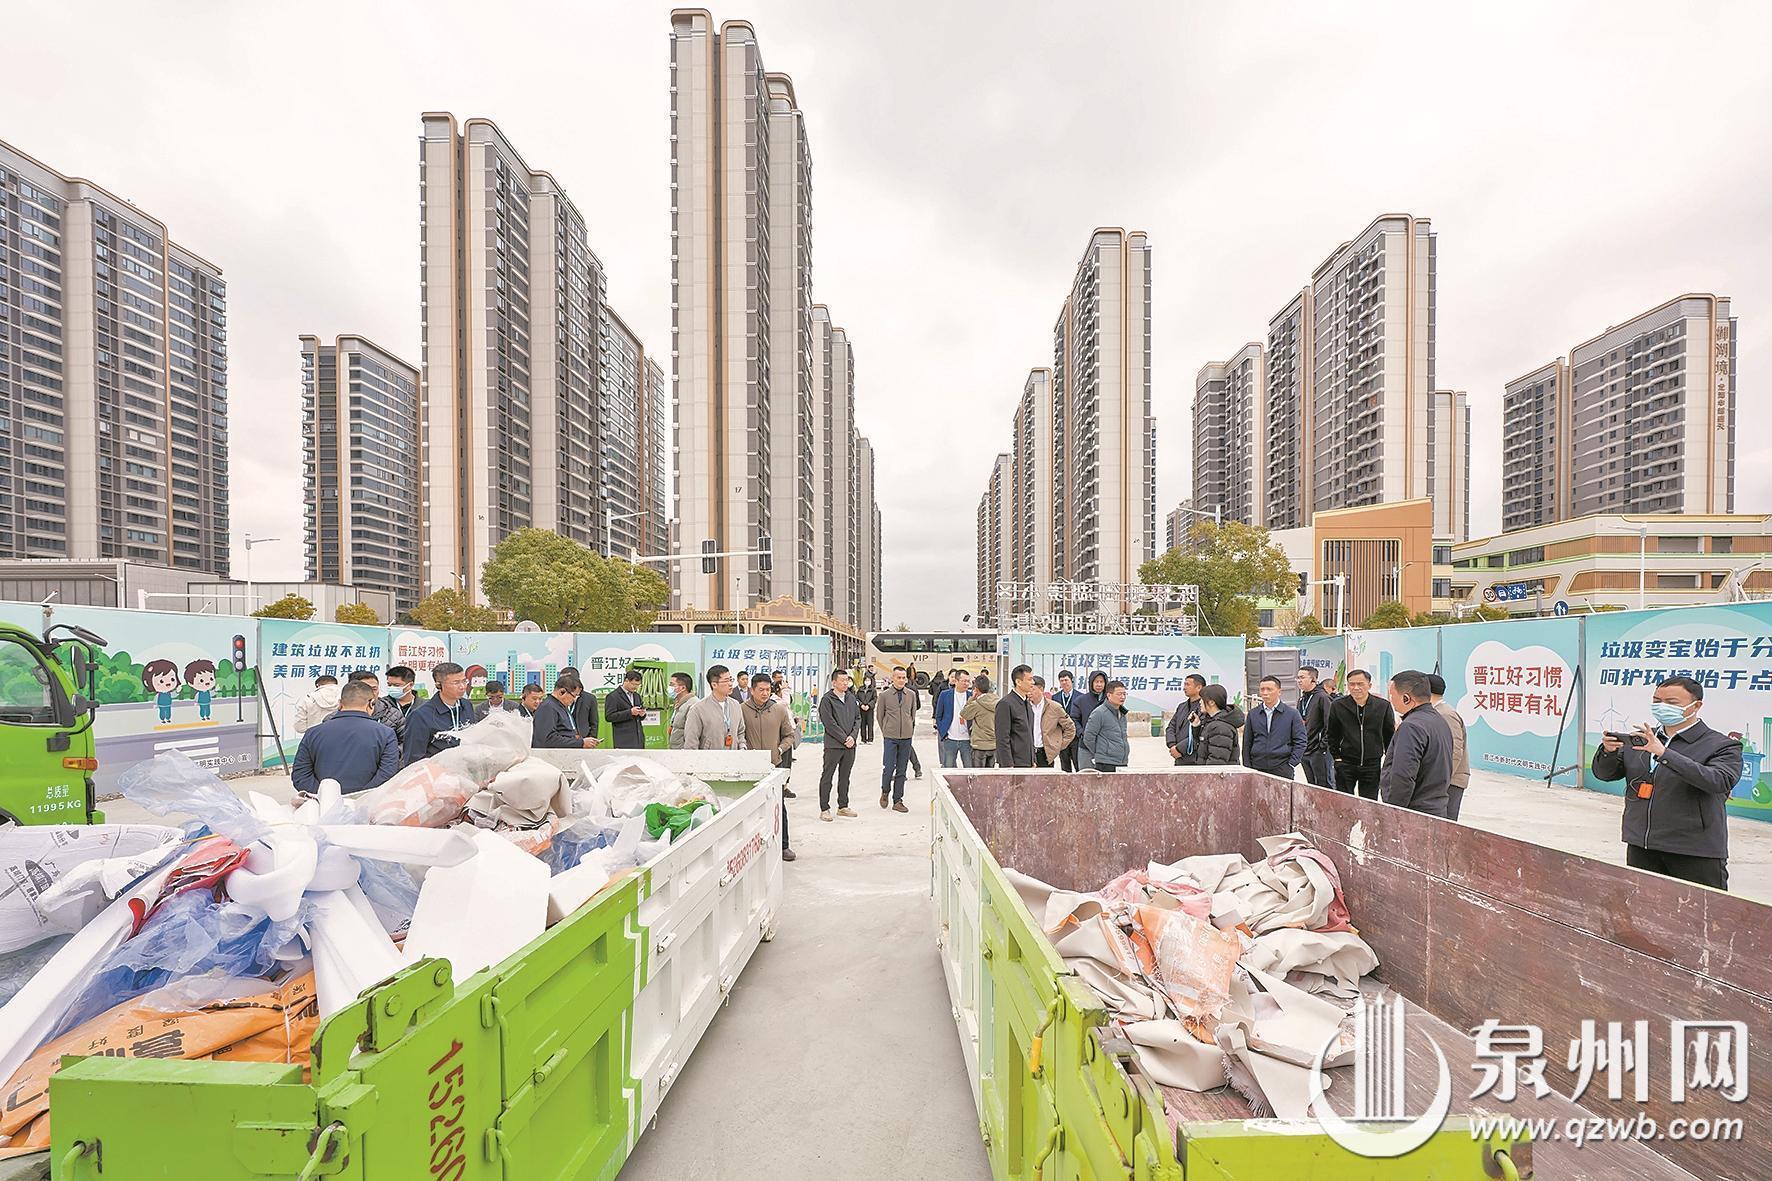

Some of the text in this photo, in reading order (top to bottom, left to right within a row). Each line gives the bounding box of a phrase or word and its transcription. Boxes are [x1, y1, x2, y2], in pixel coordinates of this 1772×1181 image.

[272, 643, 380, 658] 建筑垃圾不乱扔
[398, 645, 445, 658] 晋江好习惯
[712, 649, 788, 660] 垃圾变资源
[1600, 637, 1772, 658] 垃圾变宝始于分
[591, 656, 660, 670] 晋江好
[912, 654, 929, 662] VIP
[1060, 654, 1201, 669] 垃圾变宝始于分类
[1473, 665, 1563, 688] 晋江好习惯
[1473, 690, 1563, 716] 文明更有礼
[46, 784, 70, 799] 总质量
